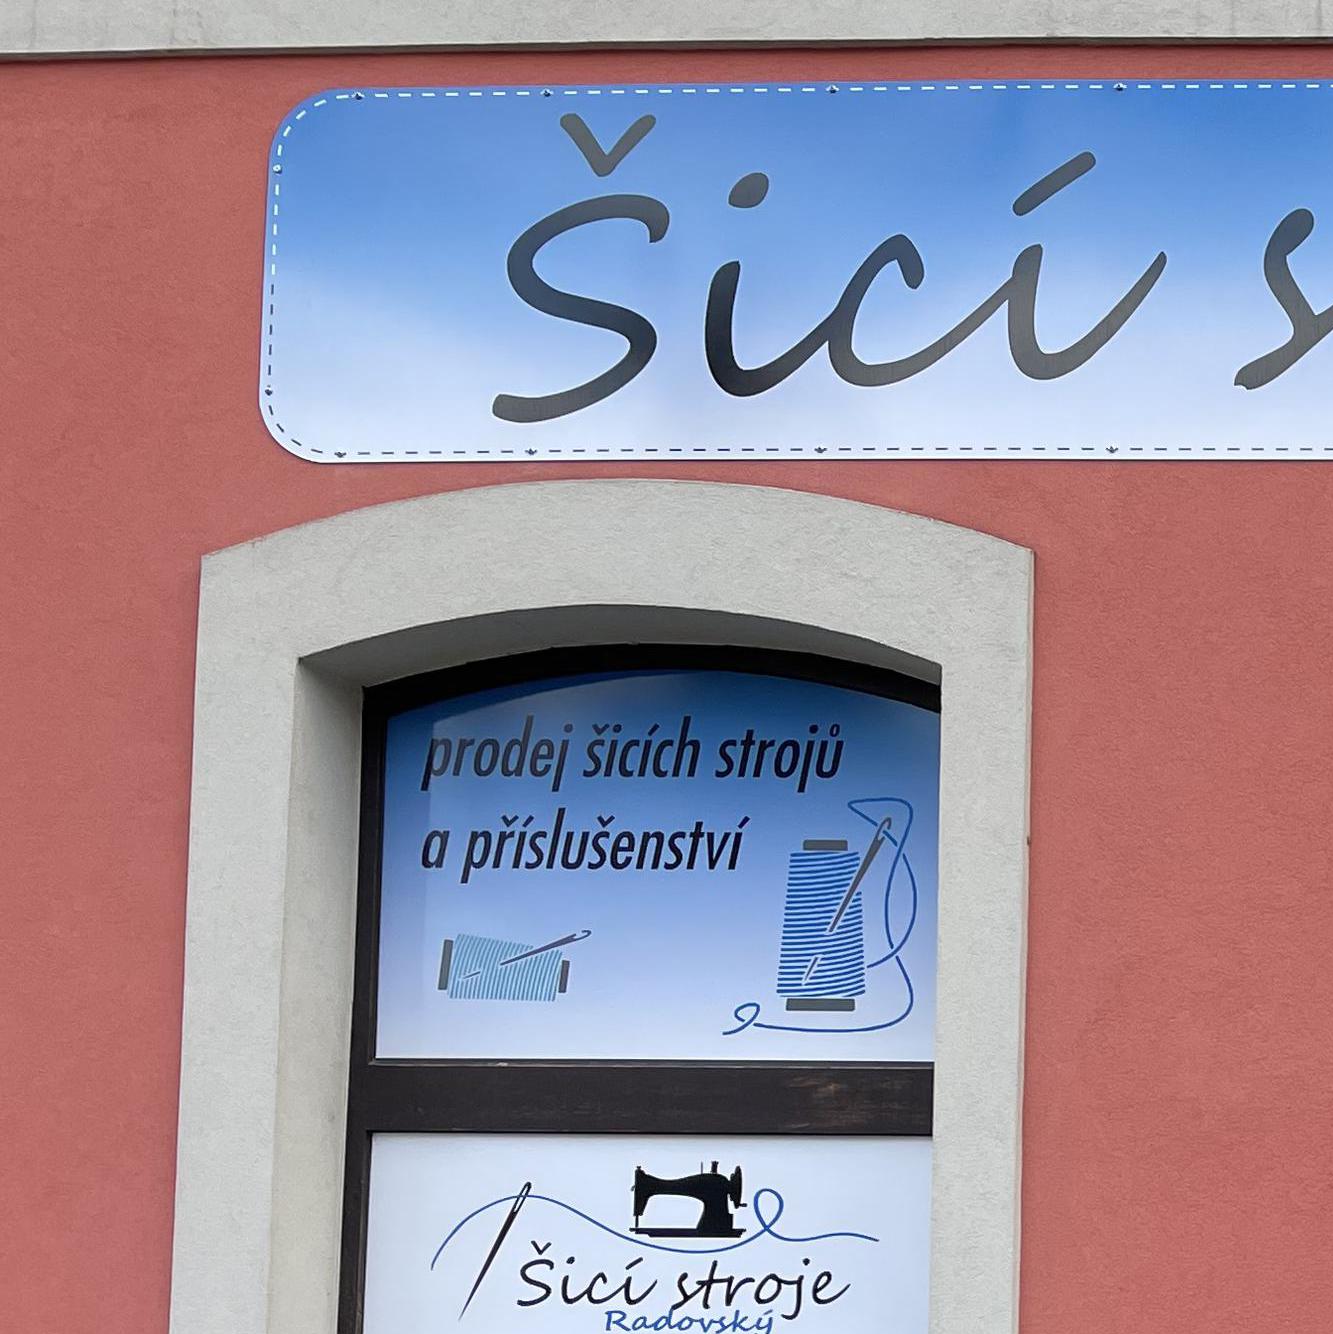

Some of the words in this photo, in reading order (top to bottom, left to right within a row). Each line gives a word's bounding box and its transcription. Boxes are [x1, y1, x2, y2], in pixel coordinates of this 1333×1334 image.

[493, 113, 1168, 422] Šicí
[421, 715, 574, 792] prodej
[582, 715, 702, 778] šicích
[715, 723, 845, 793] strojů
[421, 829, 449, 869] a
[460, 807, 750, 884] příslušenství
[517, 1240, 658, 1305] Šicí
[671, 1259, 851, 1320] stroje
